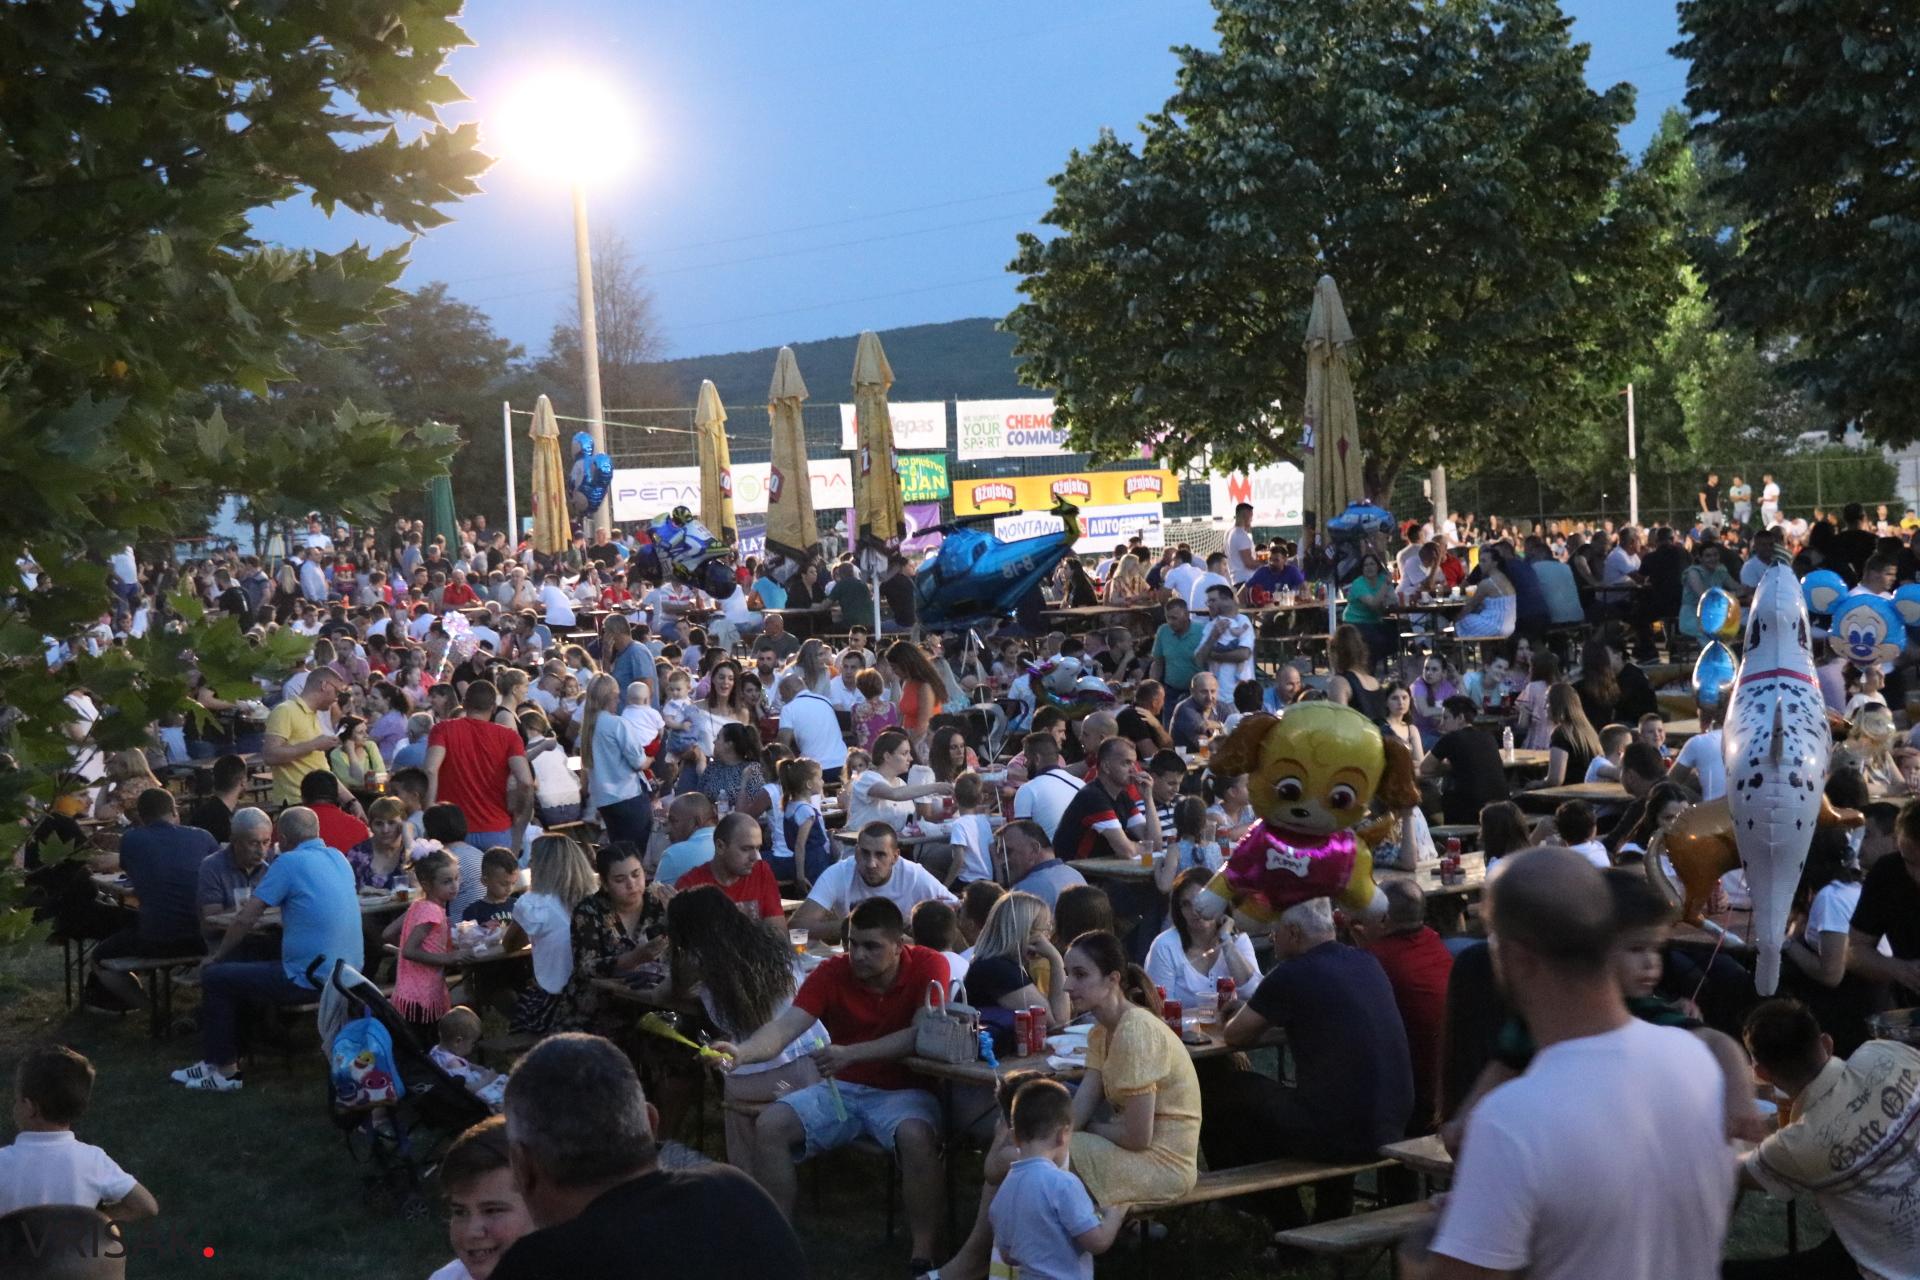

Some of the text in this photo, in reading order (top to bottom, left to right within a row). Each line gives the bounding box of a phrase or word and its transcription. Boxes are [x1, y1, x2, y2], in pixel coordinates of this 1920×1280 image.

[963, 422, 1001, 436] YOUR
[963, 436, 1001, 450] SPORT
[975, 484, 1013, 503] Ožujsko
[1255, 479, 1303, 505] Mepa
[997, 520, 1062, 540] MONTANA
